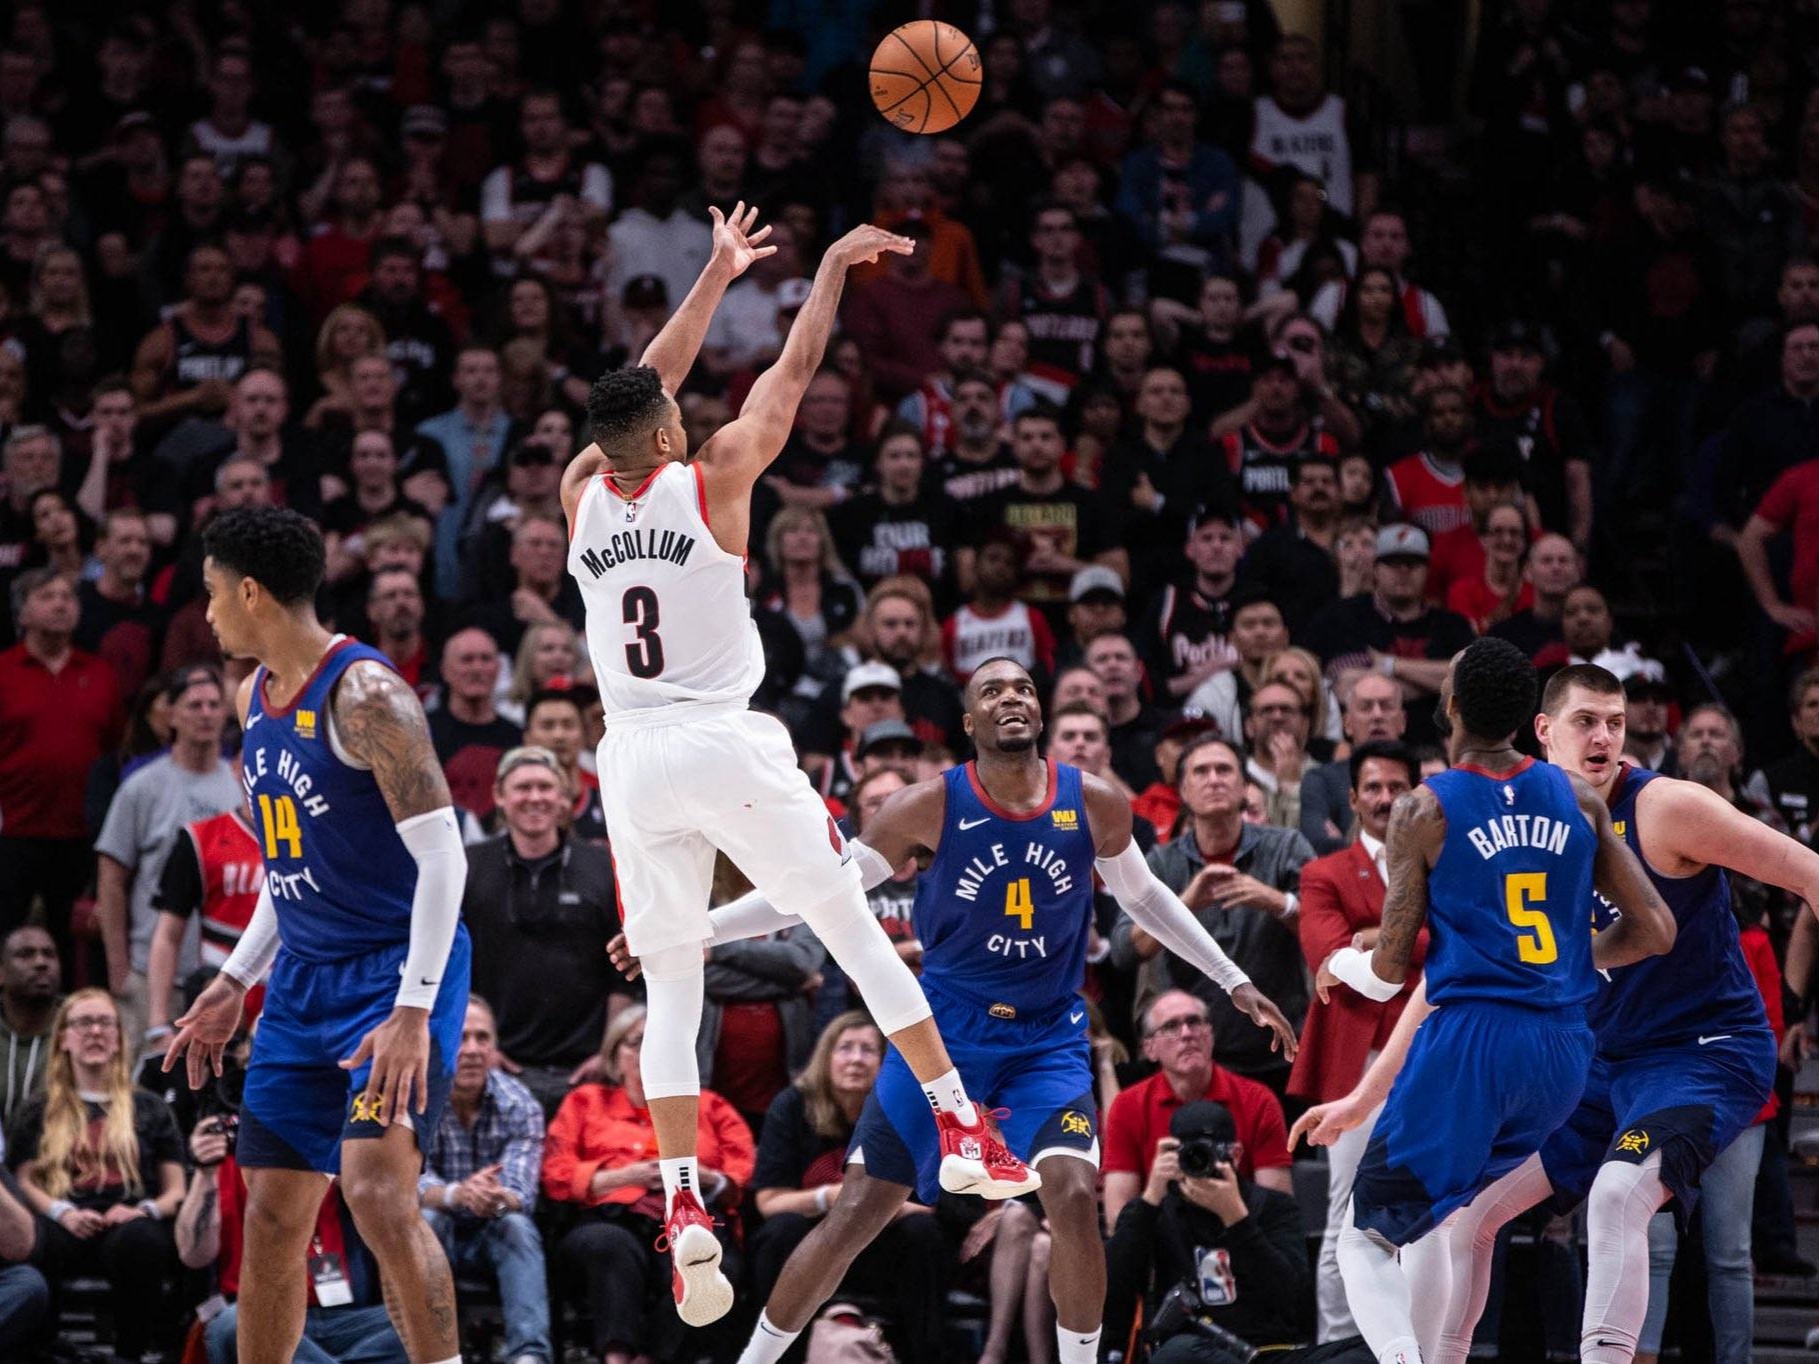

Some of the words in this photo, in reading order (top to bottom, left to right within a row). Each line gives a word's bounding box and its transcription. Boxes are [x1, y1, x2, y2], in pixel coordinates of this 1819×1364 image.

[580, 529, 695, 579] McCOLLUM
[622, 586, 665, 680] 3
[277, 749, 330, 818] HIGH
[258, 793, 302, 860] 14
[1467, 814, 1571, 860] BARTON
[269, 866, 320, 901] CITY
[955, 844, 1010, 902] MILE
[1025, 842, 1073, 895] HIGH
[1004, 878, 1034, 930] 4
[1505, 872, 1558, 965] 5
[987, 934, 1047, 959] CITY
